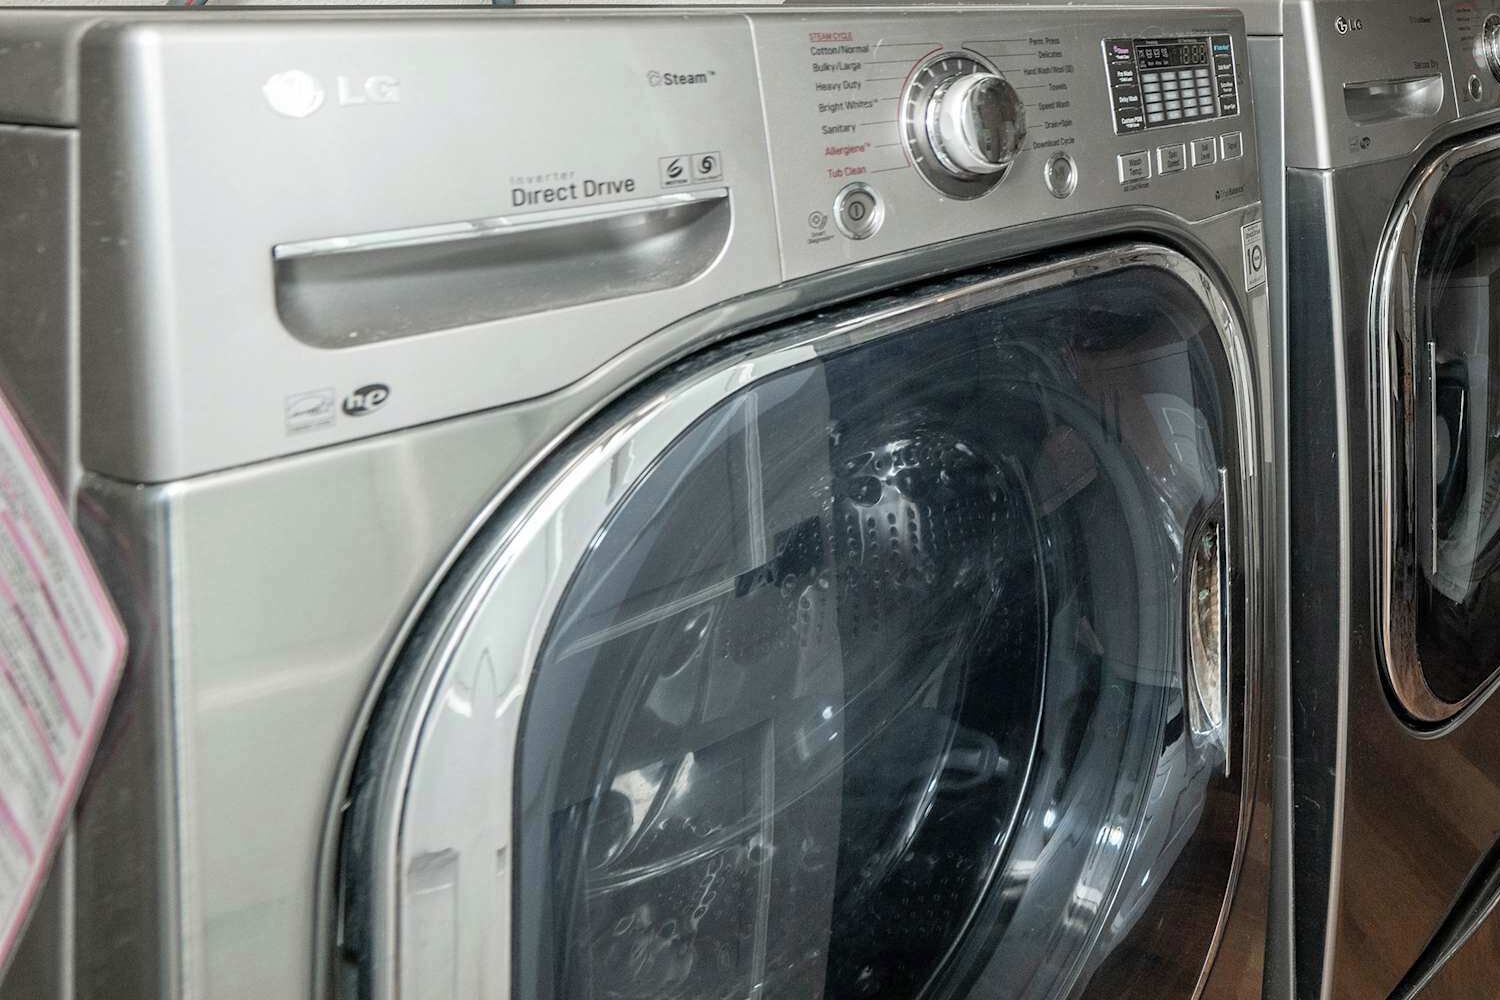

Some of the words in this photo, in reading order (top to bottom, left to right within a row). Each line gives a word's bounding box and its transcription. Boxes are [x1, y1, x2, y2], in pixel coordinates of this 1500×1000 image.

[1348, 18, 1363, 31] LG
[810, 44, 869, 56] Cotton/Normal
[812, 61, 861, 73] Bulky/Large
[336, 75, 400, 105] LG
[816, 81, 841, 92] Heavy
[843, 80, 861, 91] Duty
[819, 101, 843, 114] Bright
[821, 123, 856, 135] Sanitary
[827, 167, 843, 178] Tub
[844, 165, 866, 177] Clean
[512, 183, 578, 207] Direct
[583, 178, 635, 198] Drive
